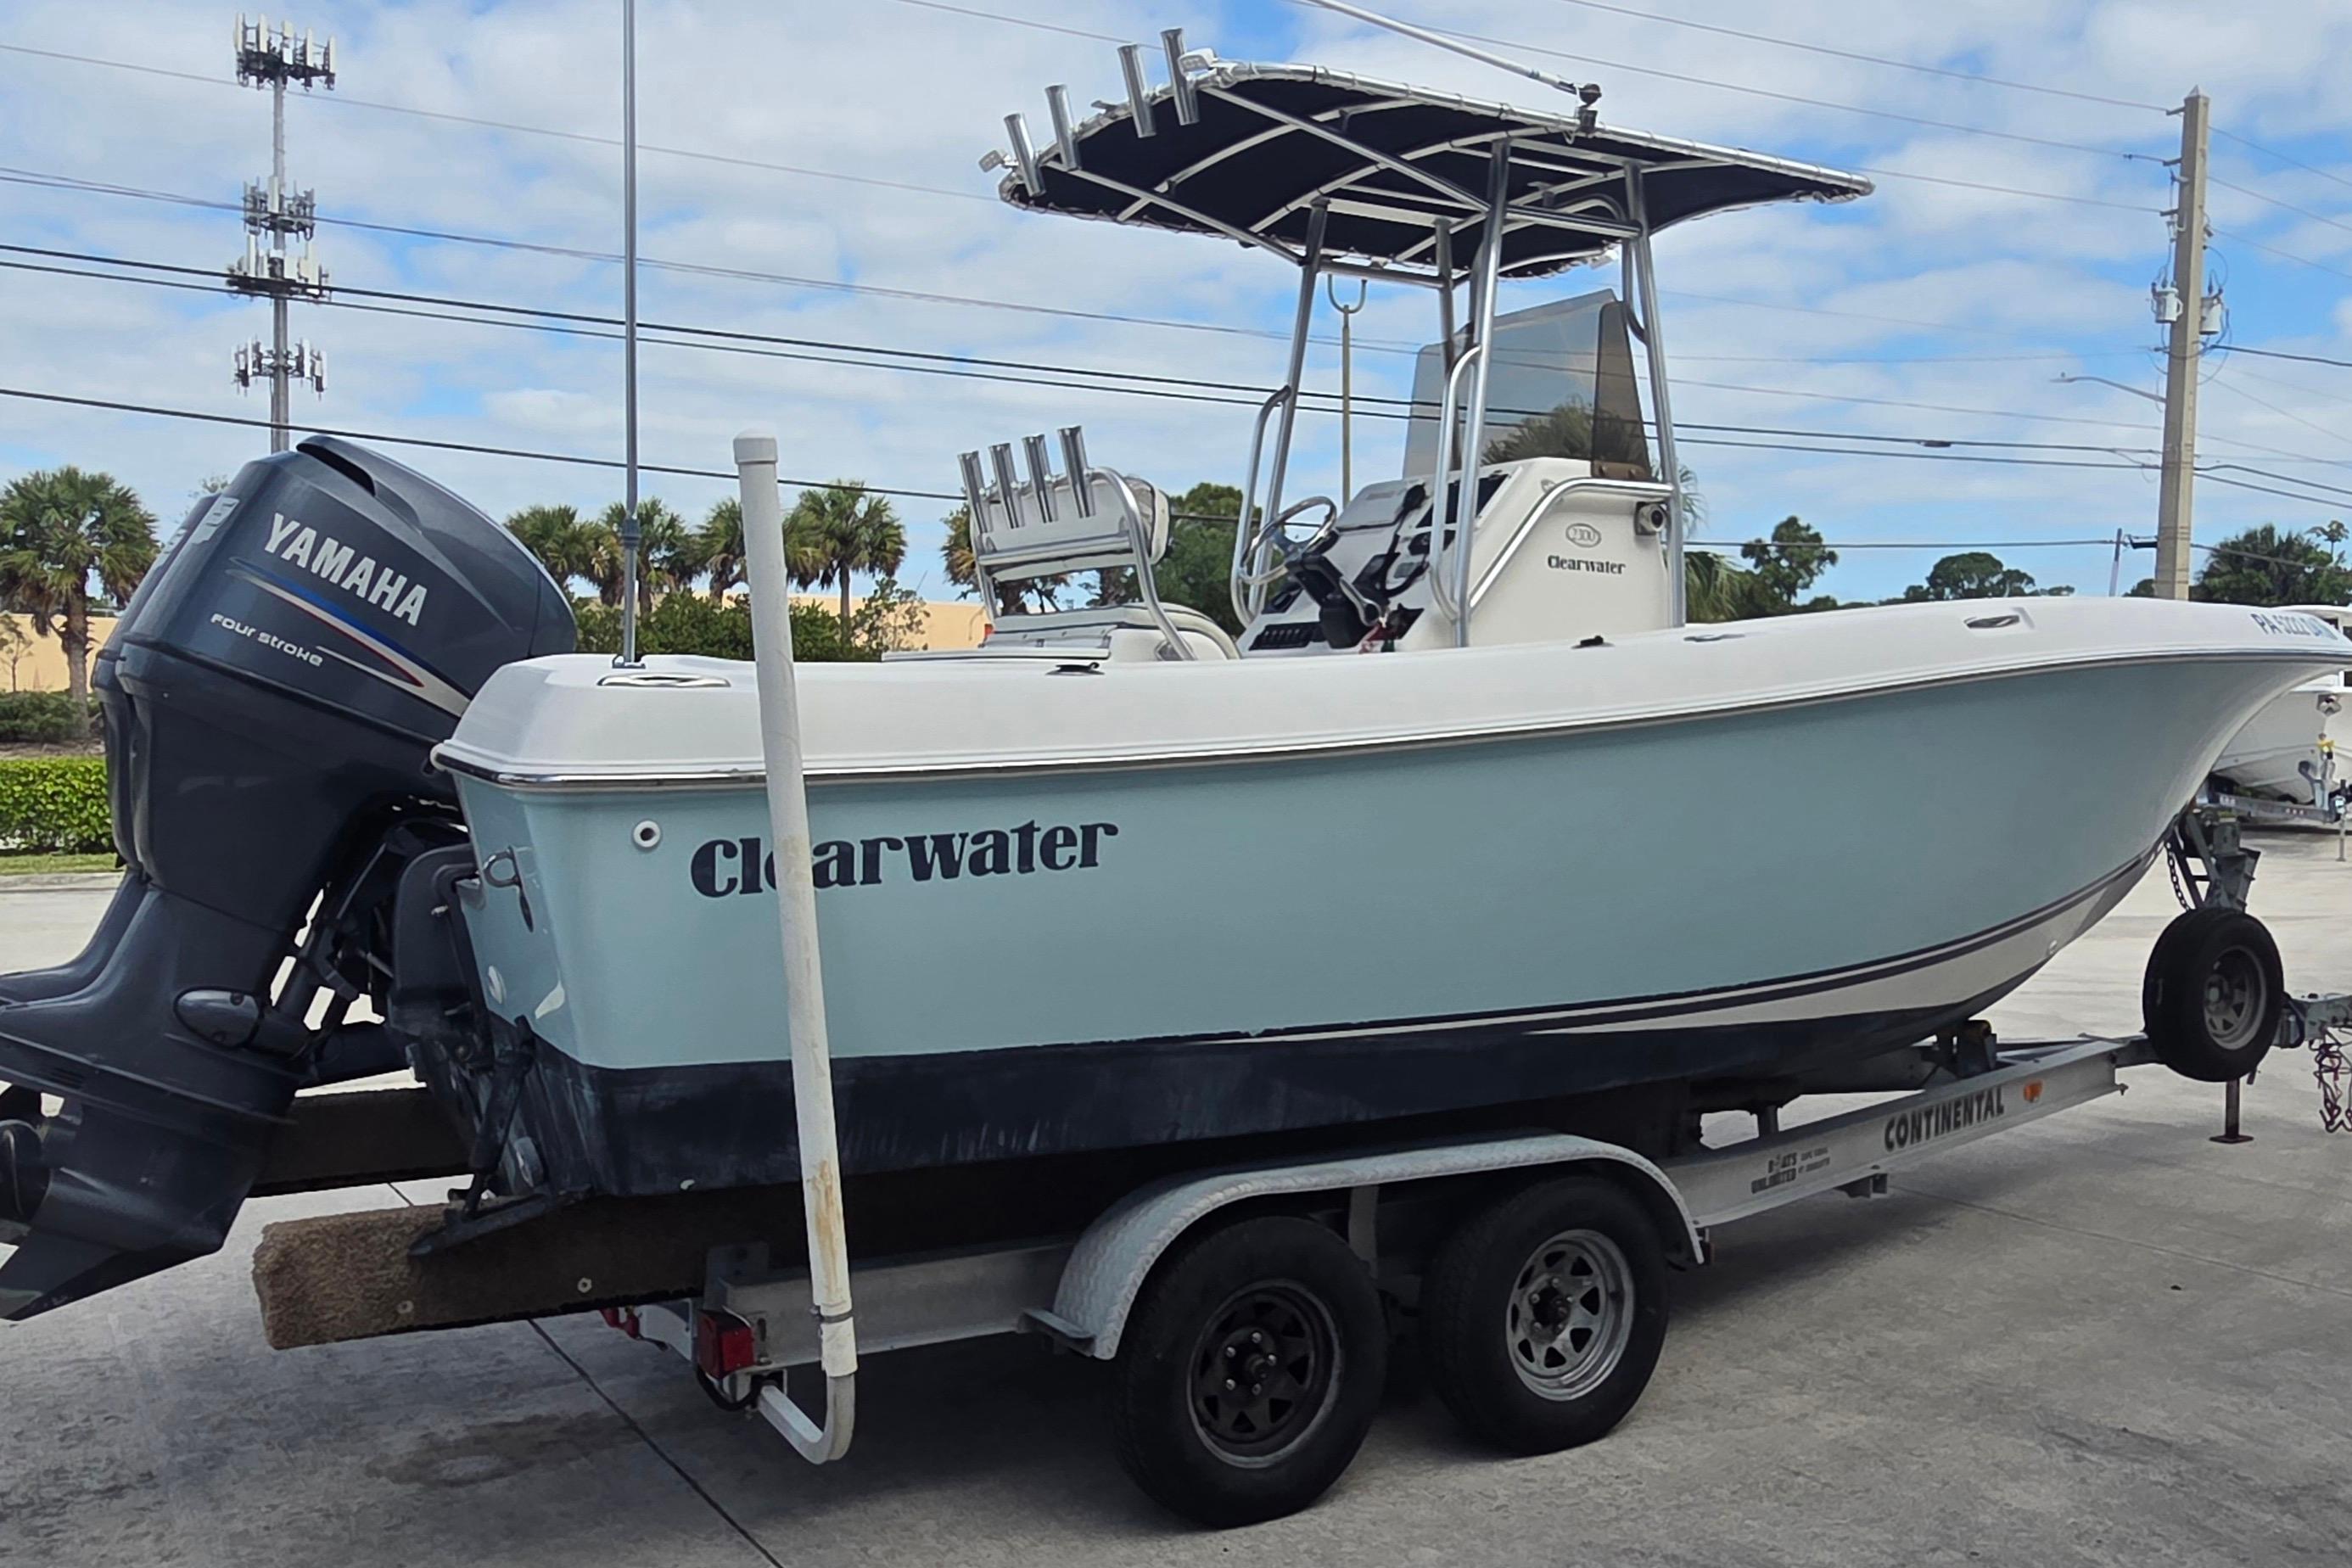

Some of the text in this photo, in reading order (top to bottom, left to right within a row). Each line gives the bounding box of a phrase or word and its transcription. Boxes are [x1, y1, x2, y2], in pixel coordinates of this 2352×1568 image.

[265, 512, 427, 626] YAMAHA
[1548, 555, 1626, 574] Clearwater
[2250, 613, 2282, 635] PA
[691, 820, 1118, 898] Clarwater
[1884, 1086, 2004, 1152] CONTINENTAL
